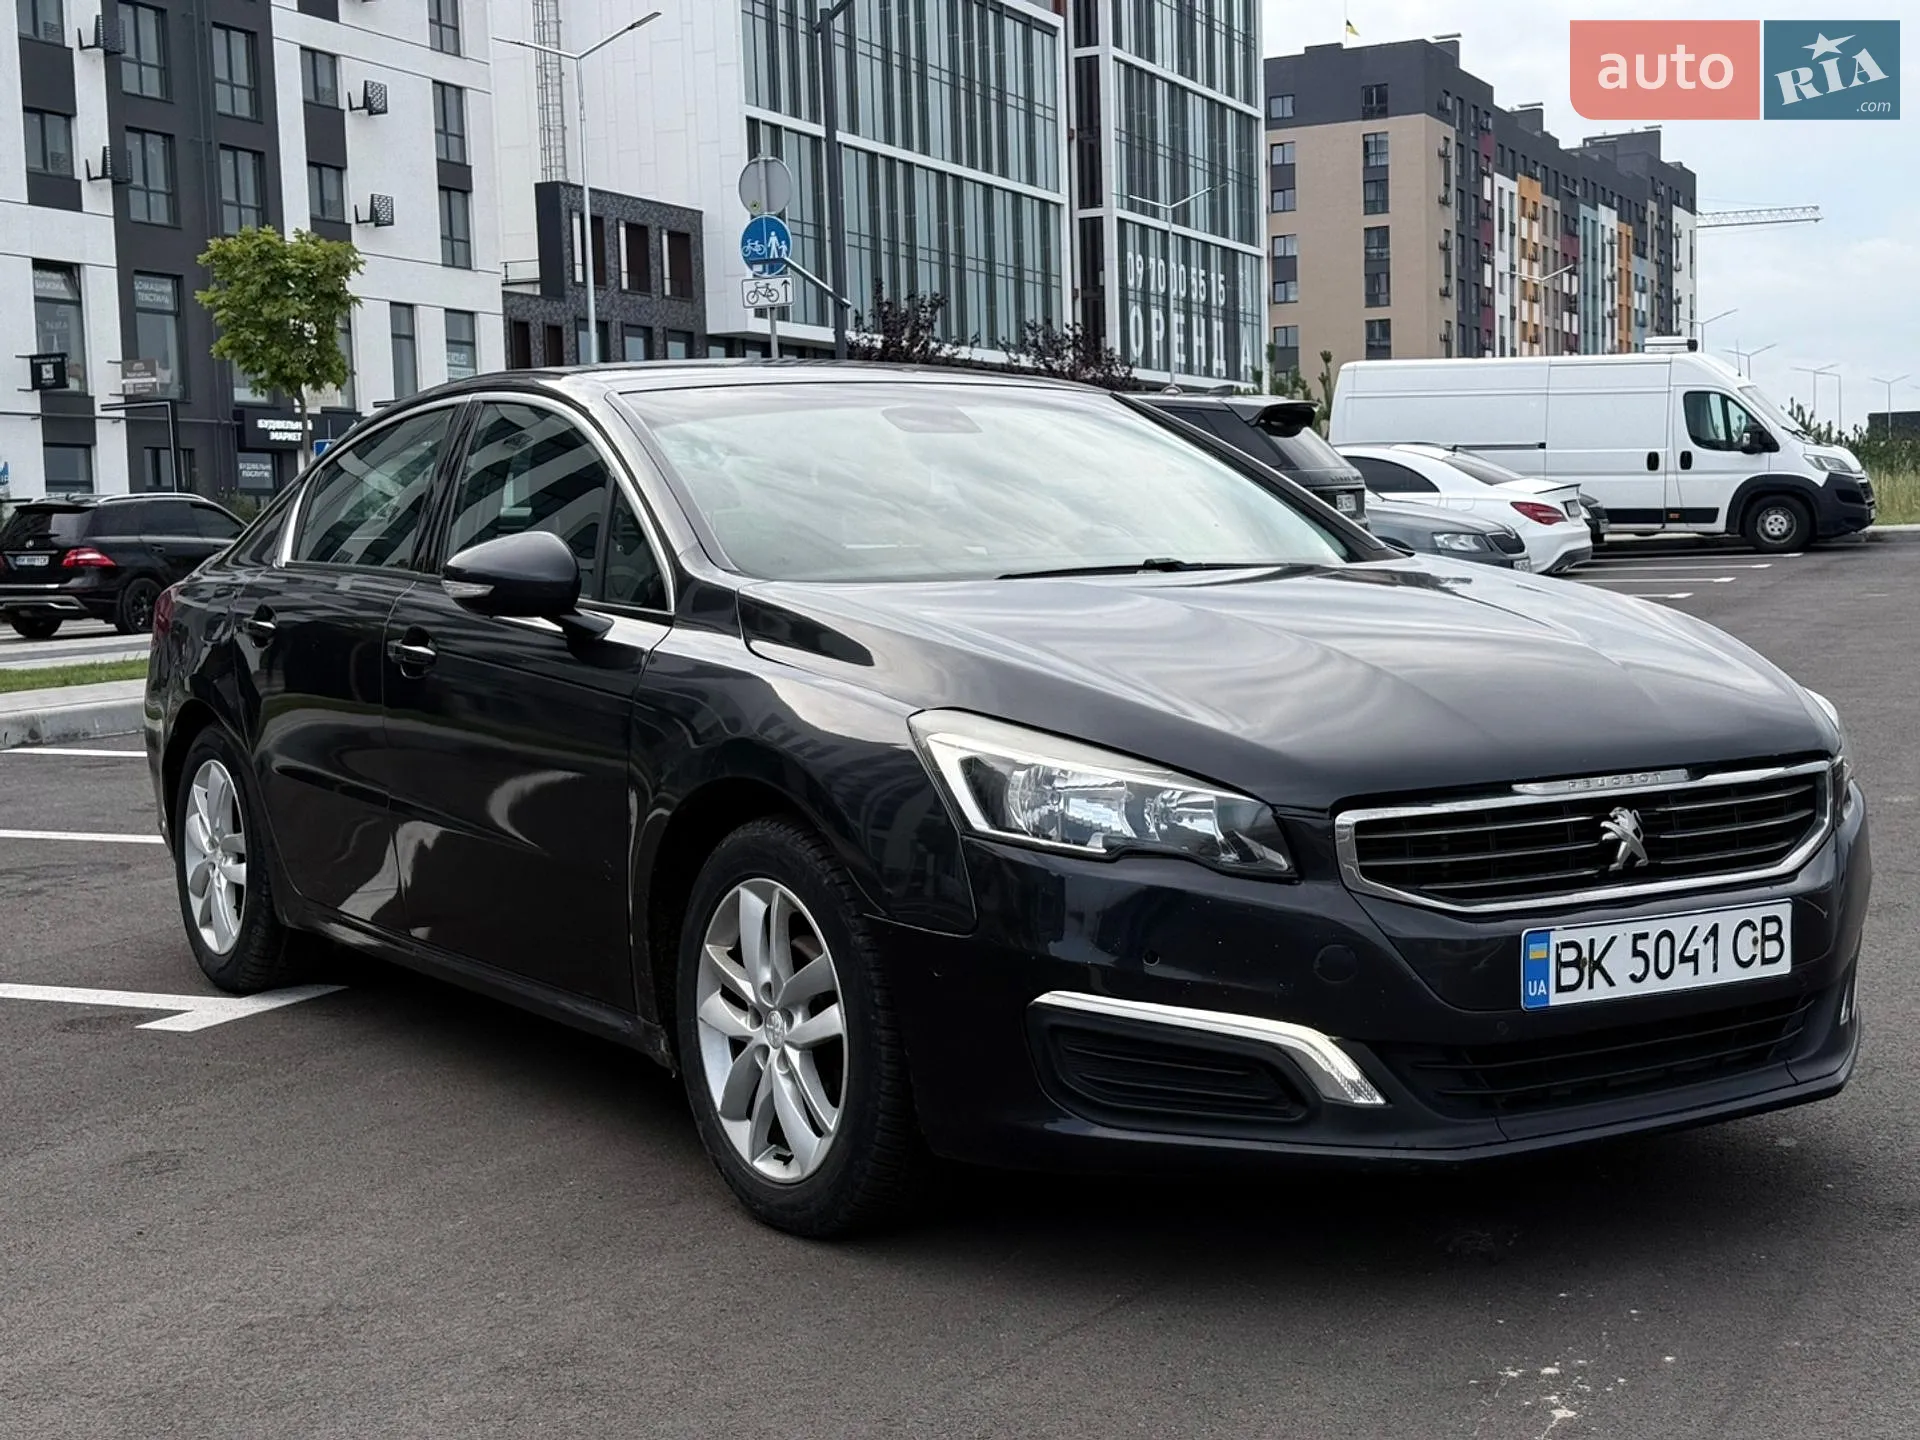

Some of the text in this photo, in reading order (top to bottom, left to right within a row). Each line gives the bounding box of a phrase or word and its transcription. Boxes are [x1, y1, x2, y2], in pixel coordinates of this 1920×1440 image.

[269, 431, 302, 441] МАРКЕТ
[1567, 772, 1662, 791] PEUGEOT
[1554, 914, 1785, 994] BK 5041 CB
[1528, 978, 1547, 996] UA
